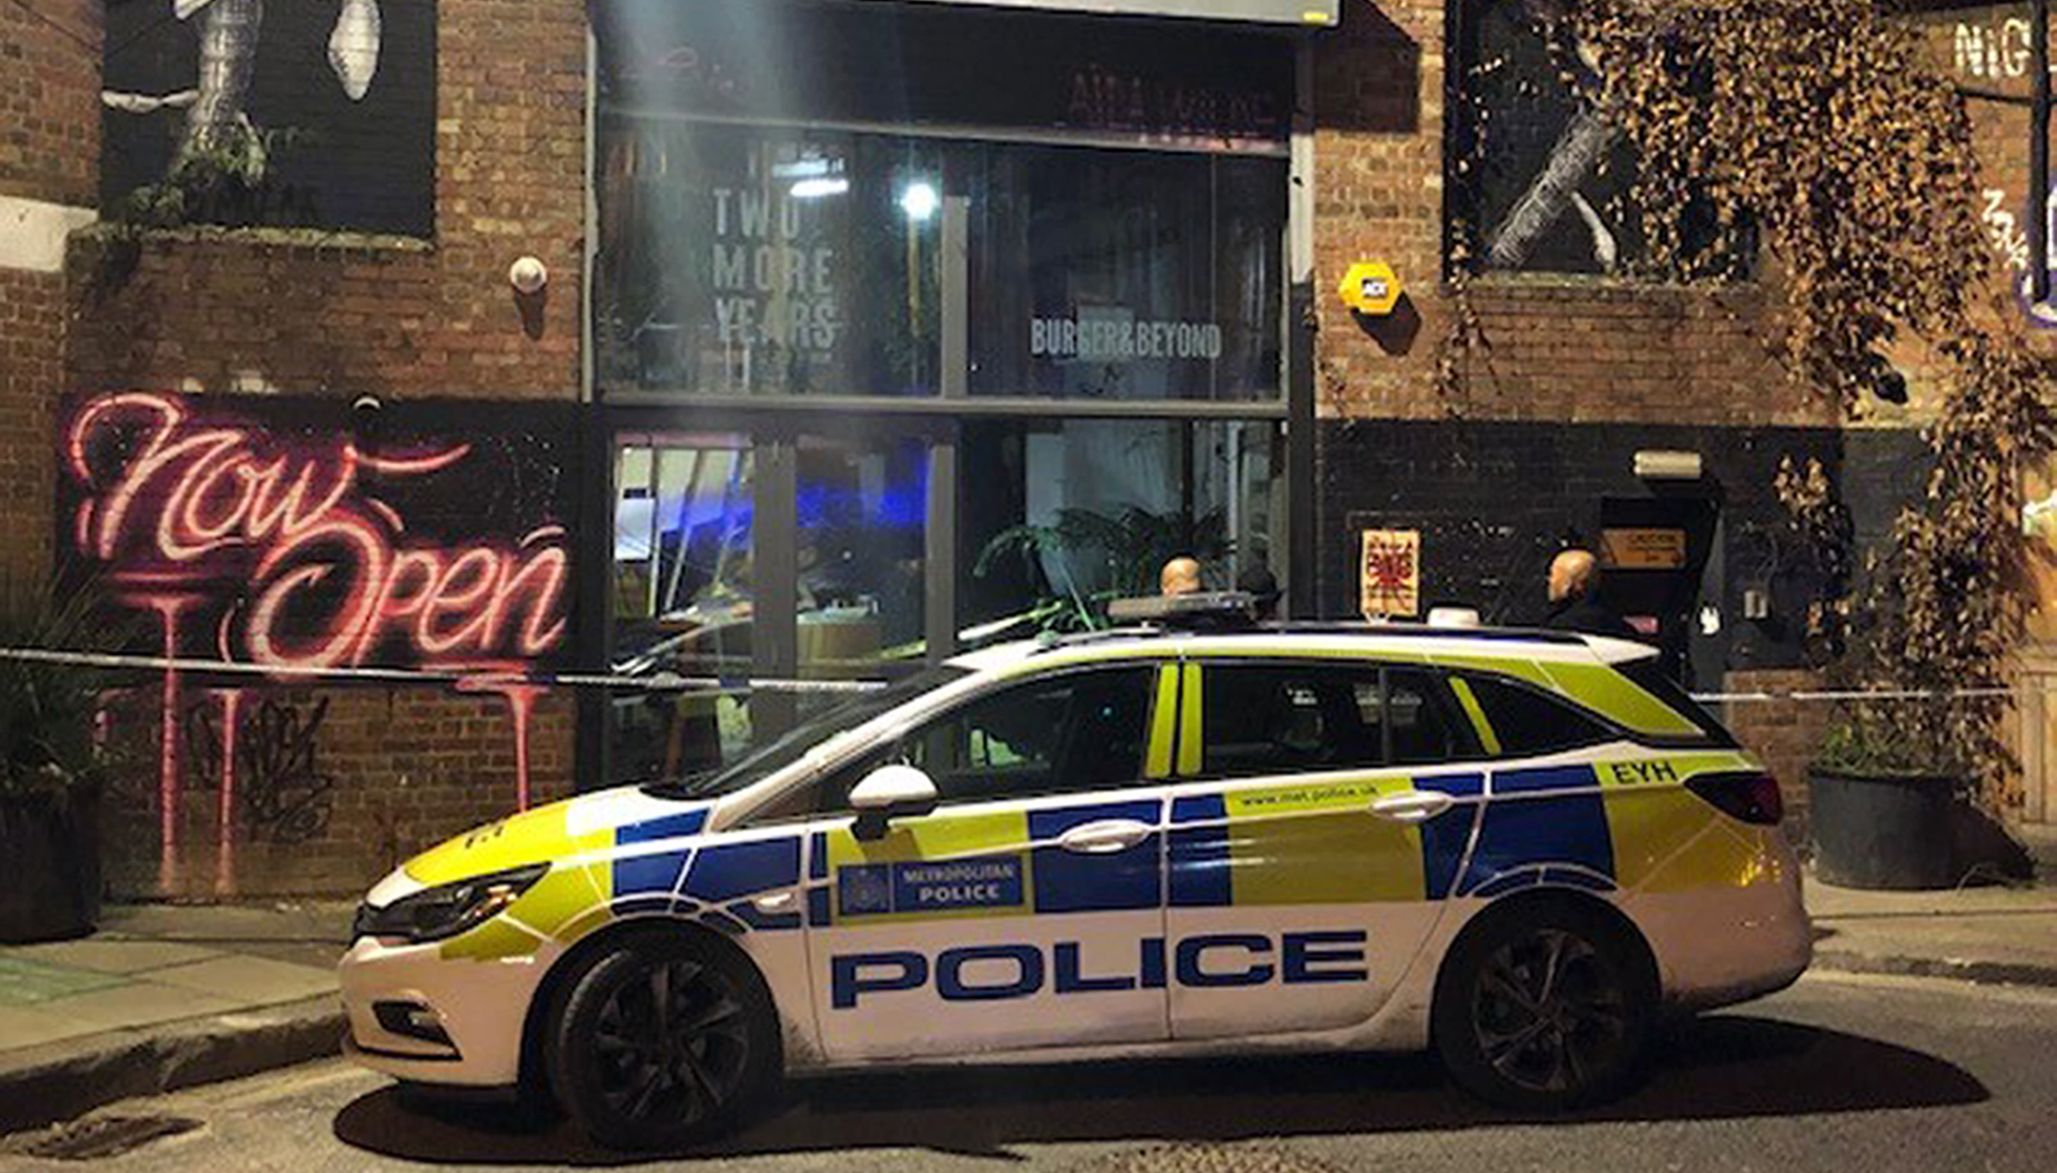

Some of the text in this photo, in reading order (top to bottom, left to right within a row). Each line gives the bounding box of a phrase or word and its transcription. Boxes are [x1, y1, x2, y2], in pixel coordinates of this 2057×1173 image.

[712, 244, 834, 294] MORE
[714, 298, 838, 348] YEARS
[1030, 318, 1222, 358] BURGER&BEYOND
[1610, 760, 1679, 784] EYH
[1241, 782, 1379, 807] www.met.police.uk
[902, 861, 1014, 883] METROPOLITAN
[918, 883, 1000, 902] POLICE
[830, 931, 1368, 1009] POLICE
